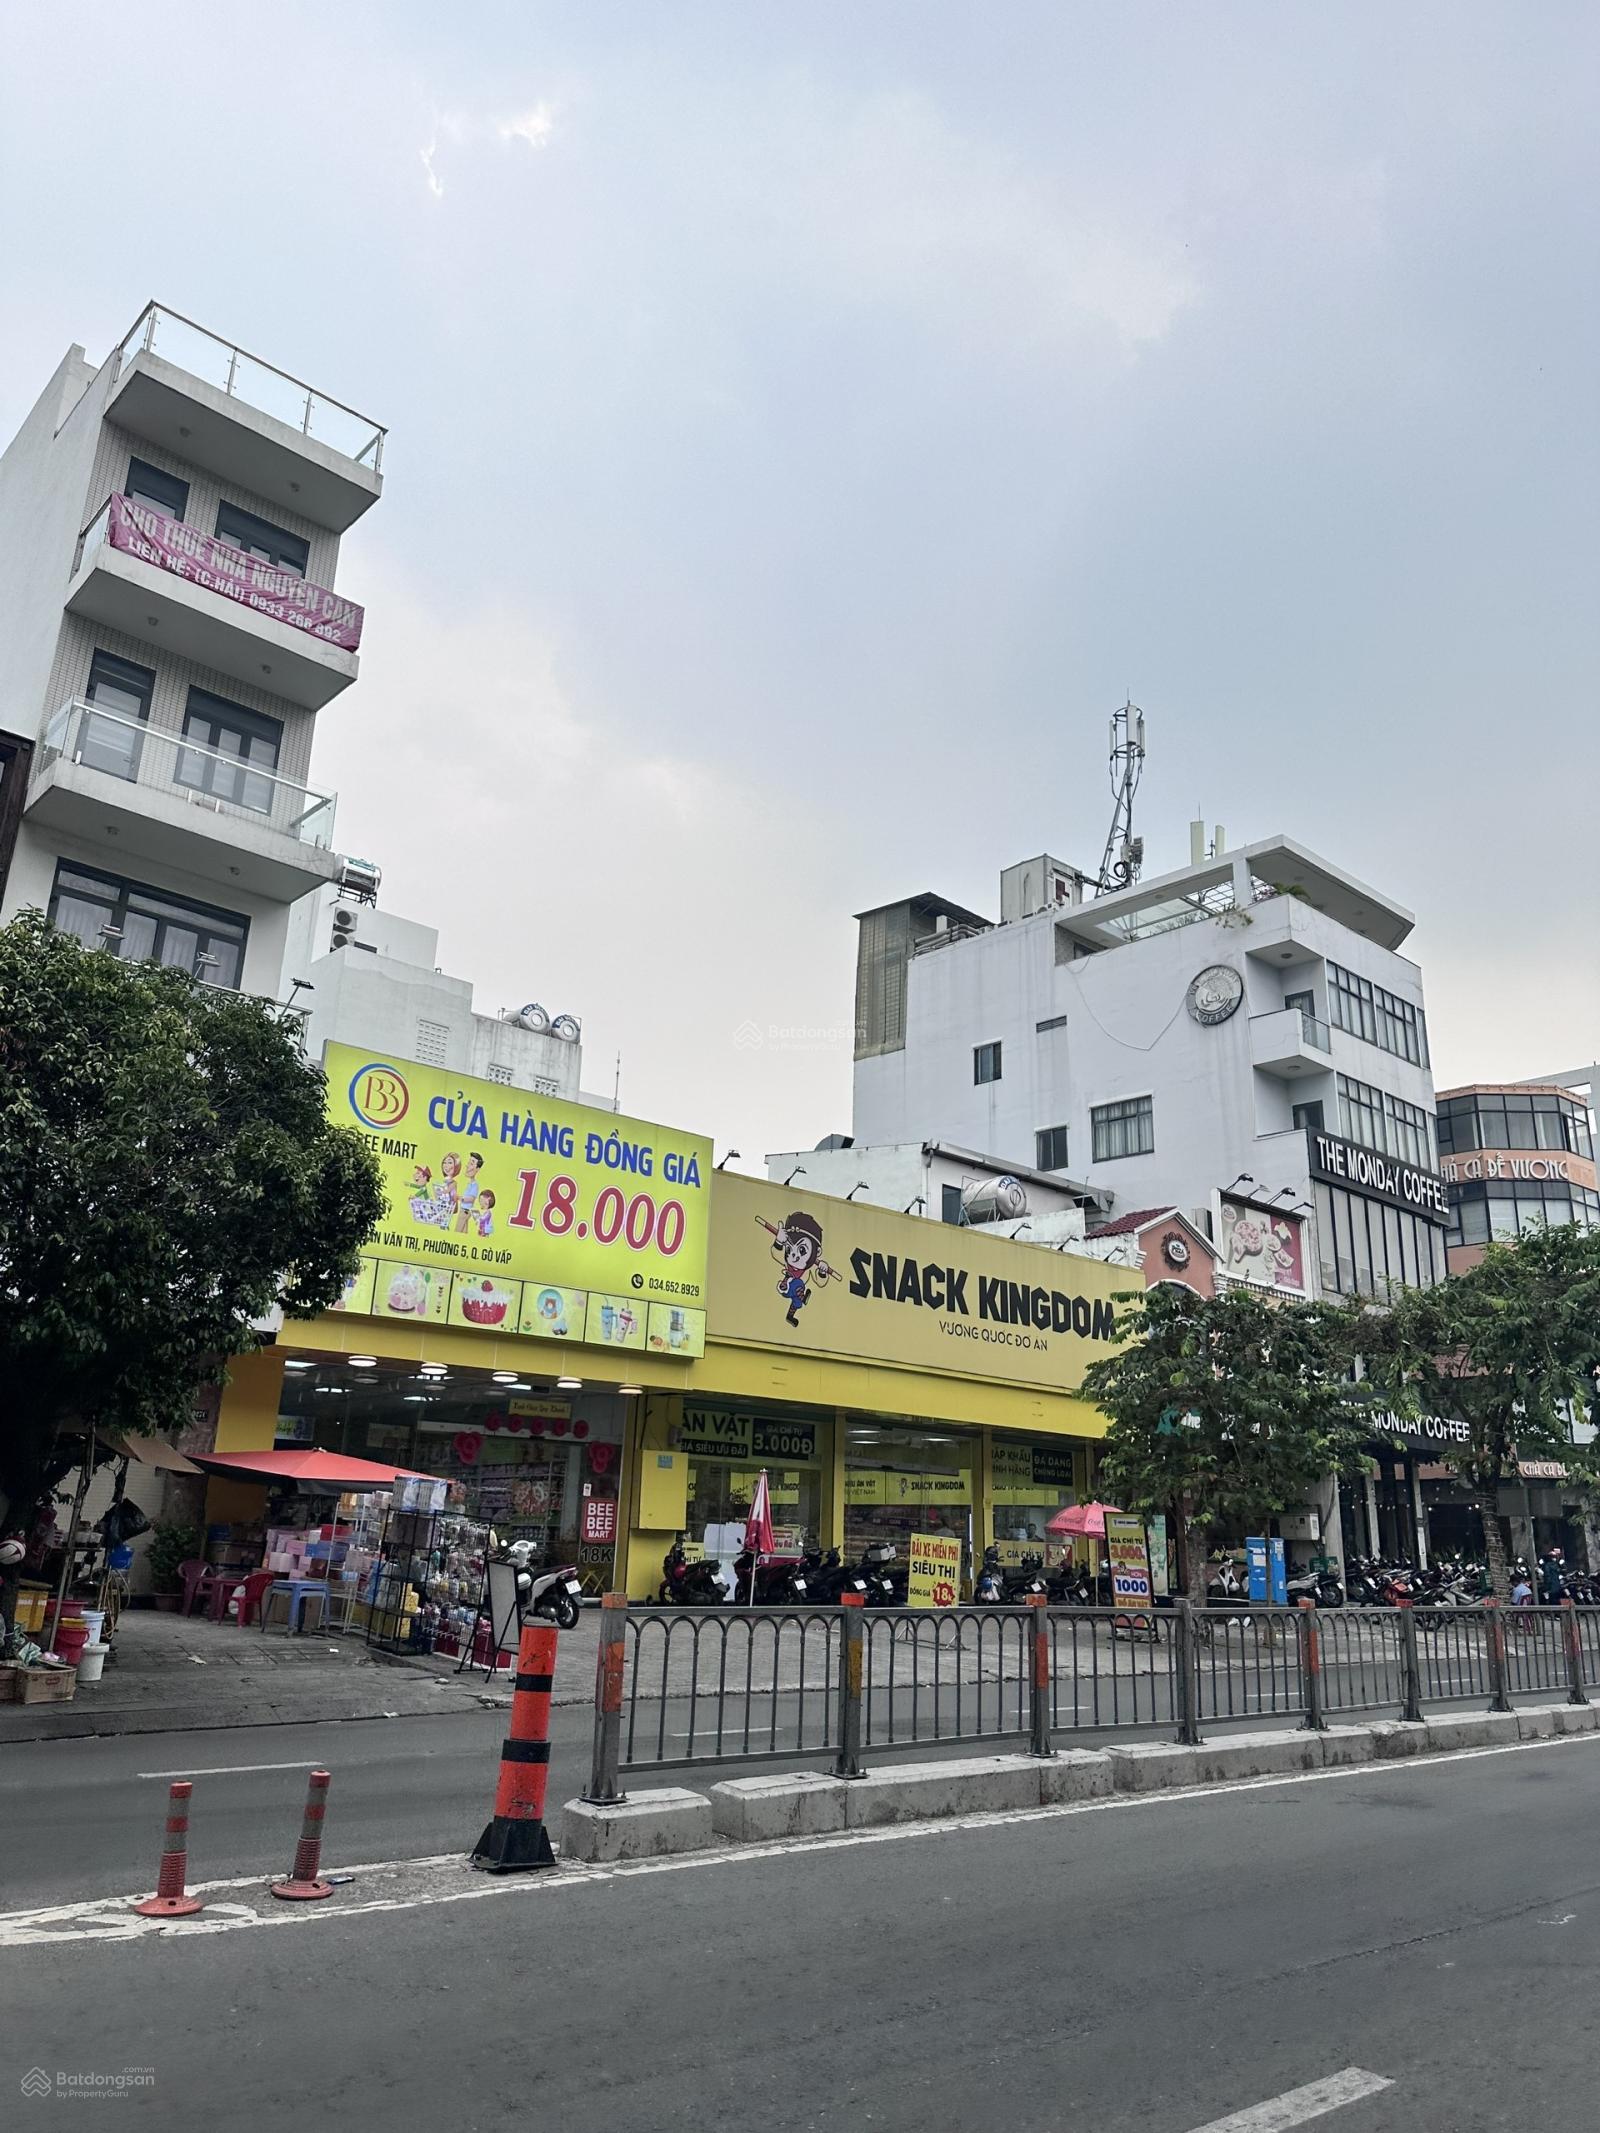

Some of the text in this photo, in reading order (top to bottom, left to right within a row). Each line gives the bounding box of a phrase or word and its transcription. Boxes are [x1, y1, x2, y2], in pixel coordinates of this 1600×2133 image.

[120, 500, 158, 538] CHO
[249, 593, 285, 618] 0933
[381, 1138, 418, 1160] MART
[428, 1090, 702, 1189] CỬA HÀNG ĐỒNG GIÁ
[1316, 1135, 1450, 1215] THE MONDAY COFFEE
[1463, 1153, 1483, 1180] CÁ
[1509, 1157, 1569, 1181] VƯƠNG
[508, 1169, 687, 1257] 18.000
[383, 1232, 403, 1248] VĂN
[460, 1246, 470, 1259] 5,
[481, 1247, 494, 1263] GÒ
[495, 1248, 513, 1265] VẤP
[849, 1247, 1118, 1342] SNACK KINGDOM
[1425, 1415, 1470, 1442] COFFEE
[753, 1432, 814, 1455] 3.000Đ
[934, 1480, 966, 1492] KINGDOM
[588, 1503, 614, 1516] BEE
[587, 1516, 613, 1530] BEE
[588, 1530, 610, 1538] MART
[581, 1546, 615, 1563] 18K
[912, 1559, 956, 1583] SIÊU THỊ
[1116, 1577, 1148, 1594] 1000
